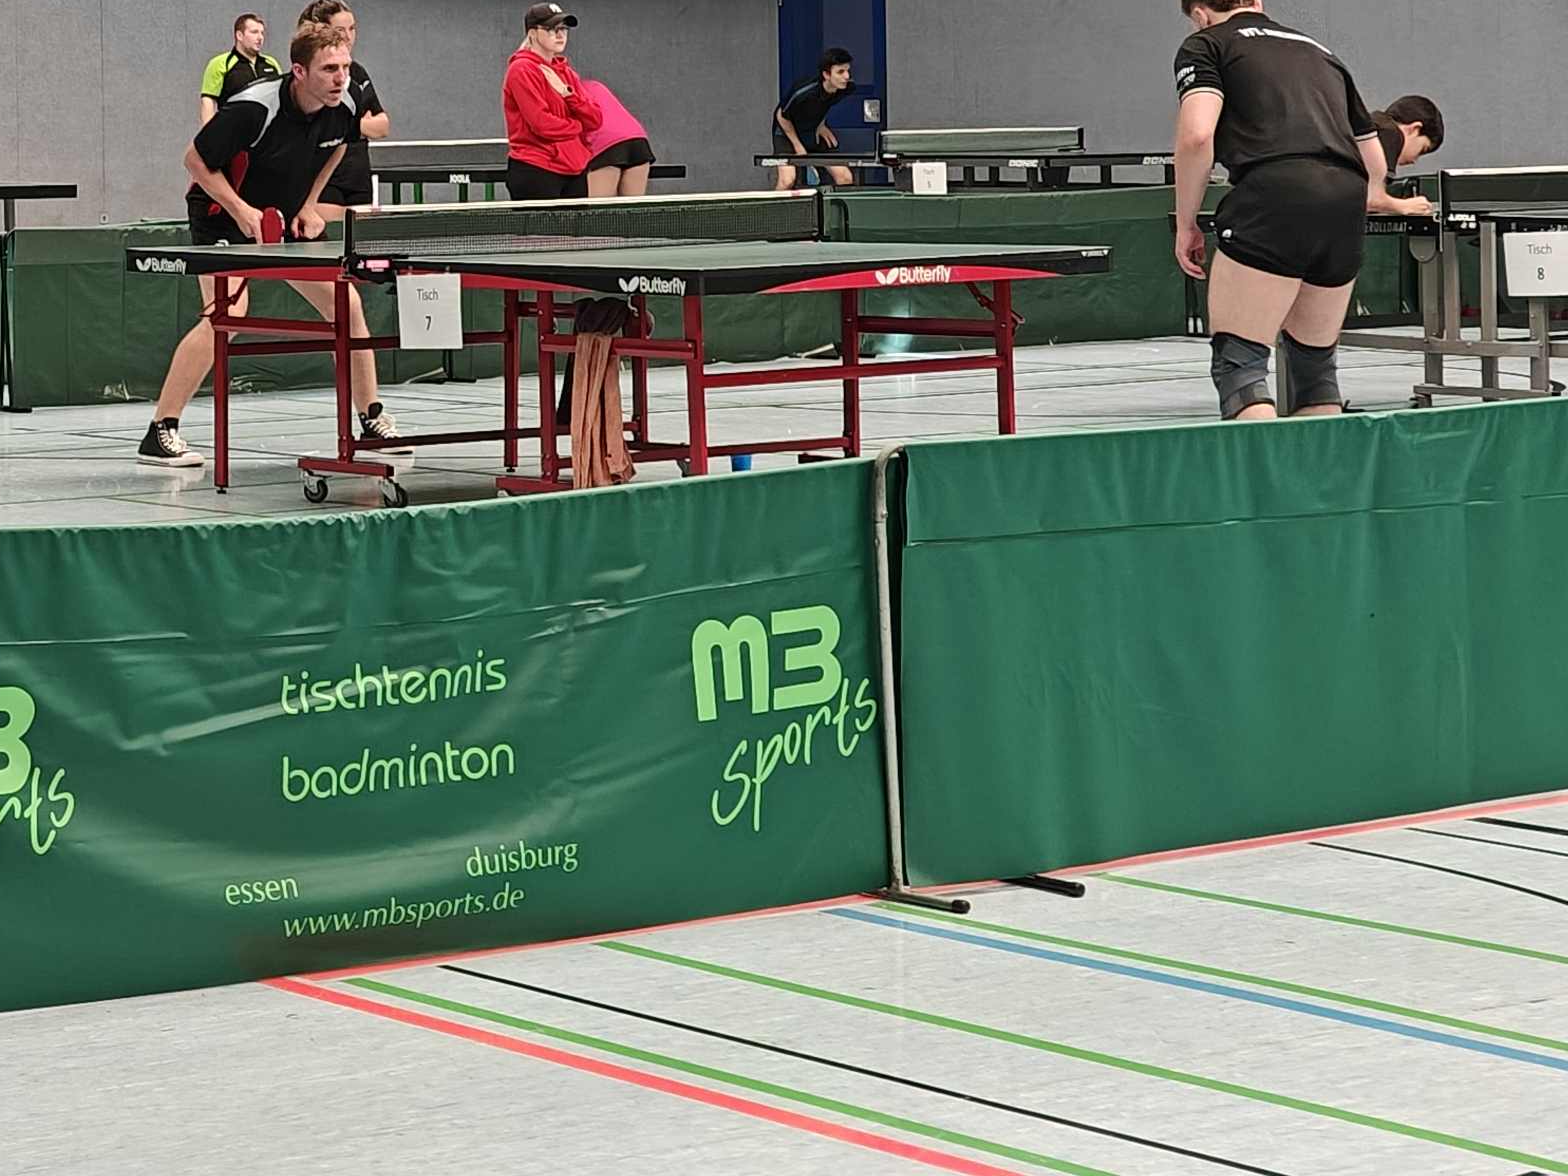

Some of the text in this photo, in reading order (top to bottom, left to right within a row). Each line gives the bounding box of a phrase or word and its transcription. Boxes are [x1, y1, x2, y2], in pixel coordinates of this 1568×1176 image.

[1526, 243, 1553, 255] Tisch
[151, 256, 187, 276] Butterfly
[899, 264, 952, 284] Butterfly
[1537, 266, 1545, 281] 8
[416, 287, 439, 301] Tisch
[639, 275, 687, 297] Butterfly
[425, 315, 432, 331] 7
[281, 649, 507, 716] tischtennis
[281, 741, 515, 802] badminton
[465, 840, 578, 877] duisburg
[225, 877, 299, 906] essen
[283, 881, 525, 938] www.mbsports.de
